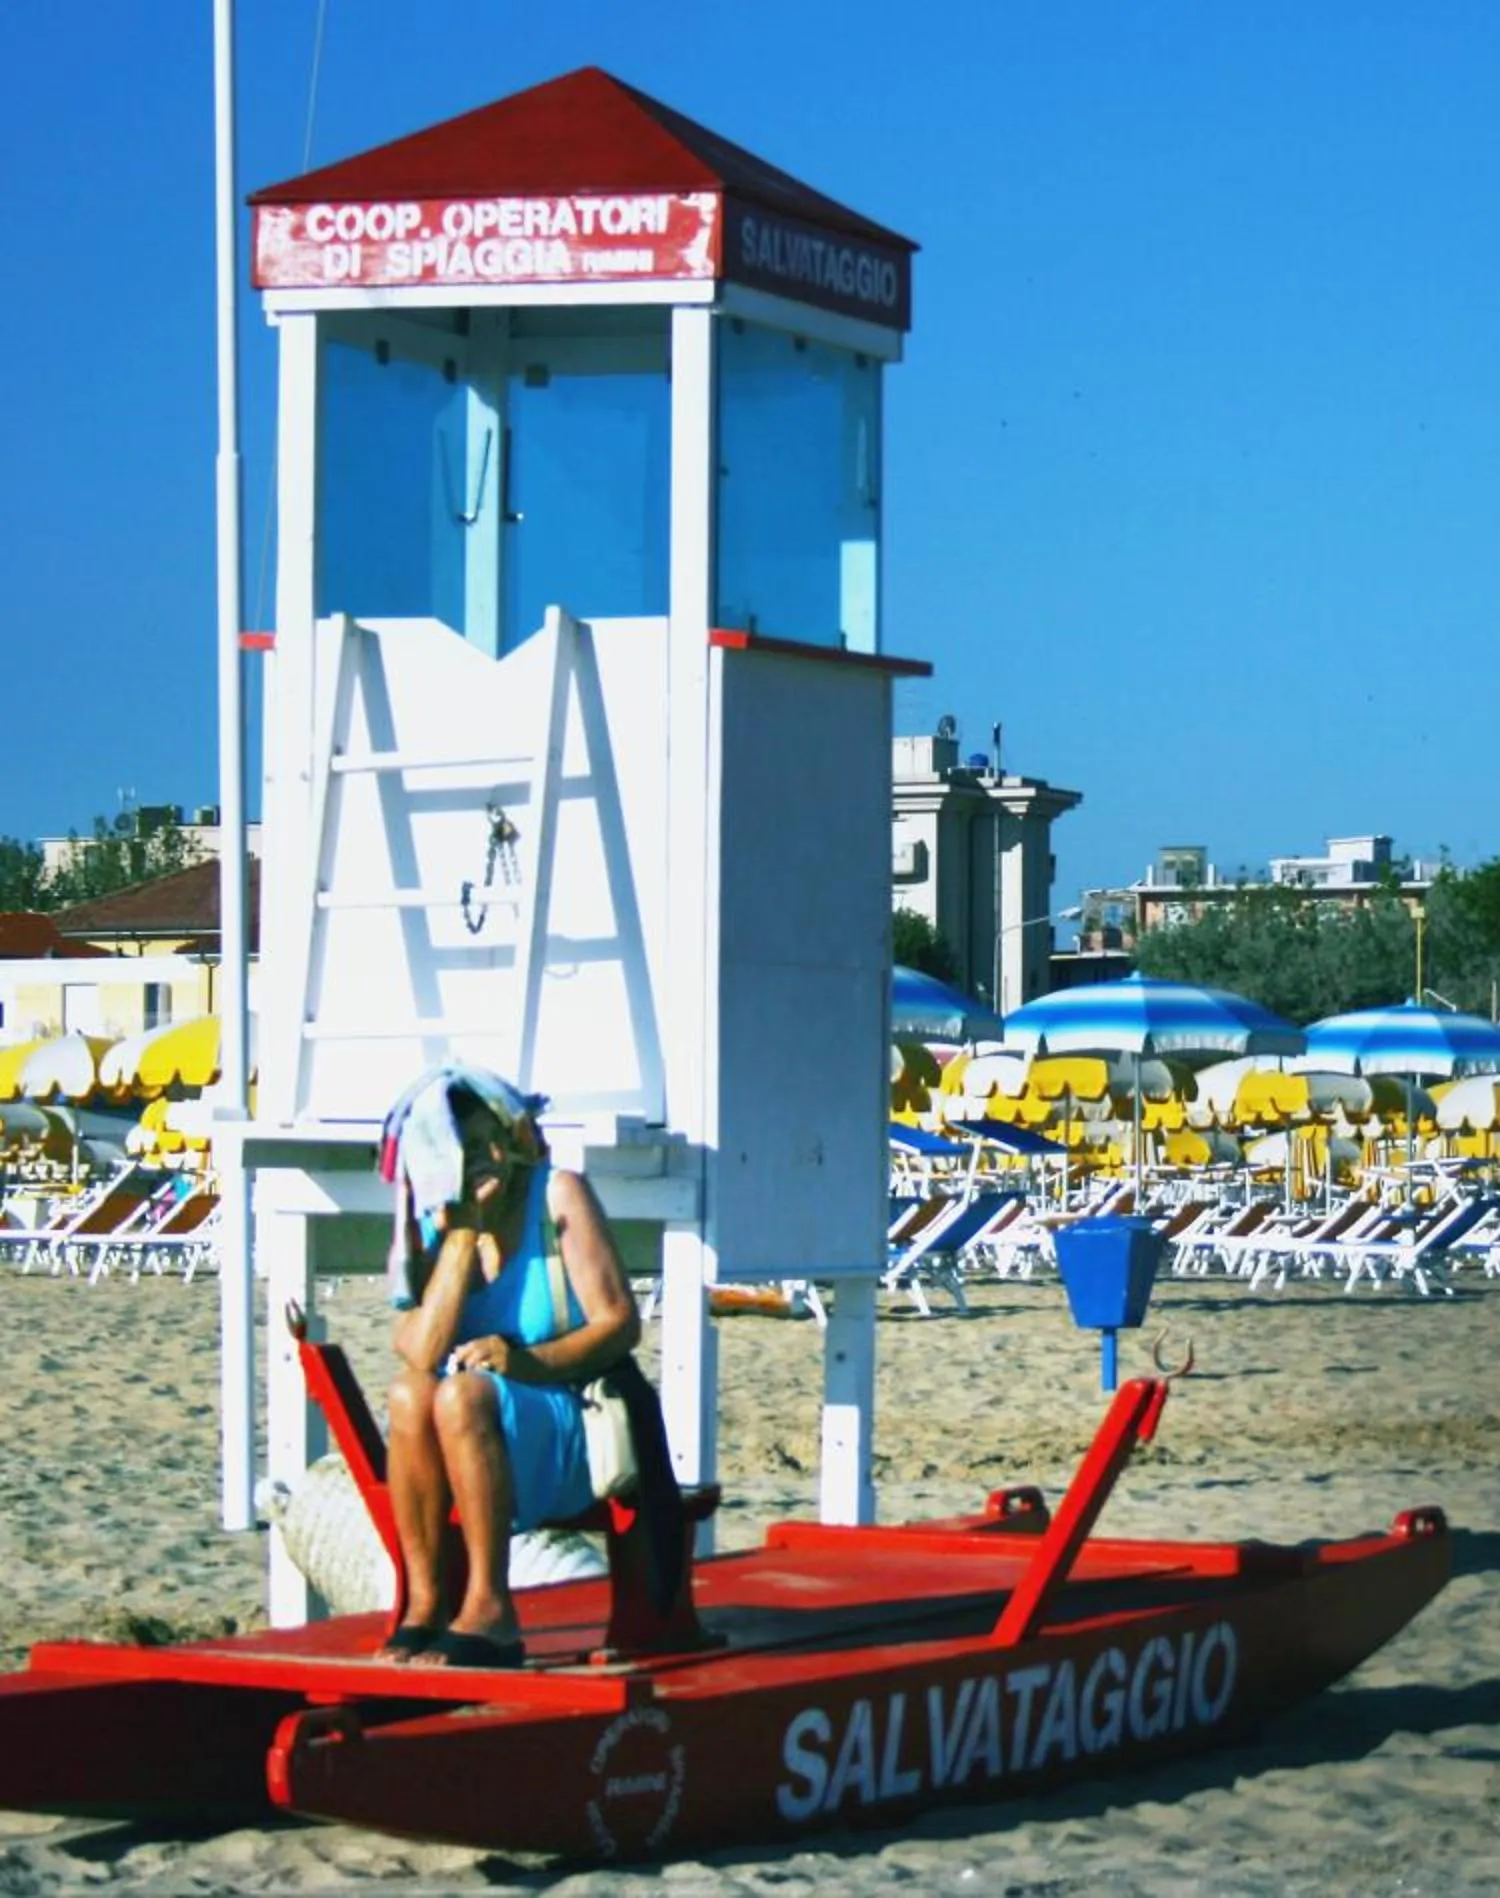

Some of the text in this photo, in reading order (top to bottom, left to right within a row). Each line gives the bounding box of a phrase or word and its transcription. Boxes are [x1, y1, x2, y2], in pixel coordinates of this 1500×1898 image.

[304, 196, 670, 242] COOP. OPERATORI
[322, 243, 362, 279] DI
[386, 238, 573, 278] SPIAGGIA
[740, 214, 898, 309] SALVATAGGIO
[775, 1619, 1239, 1822] SALVATAGGIO
